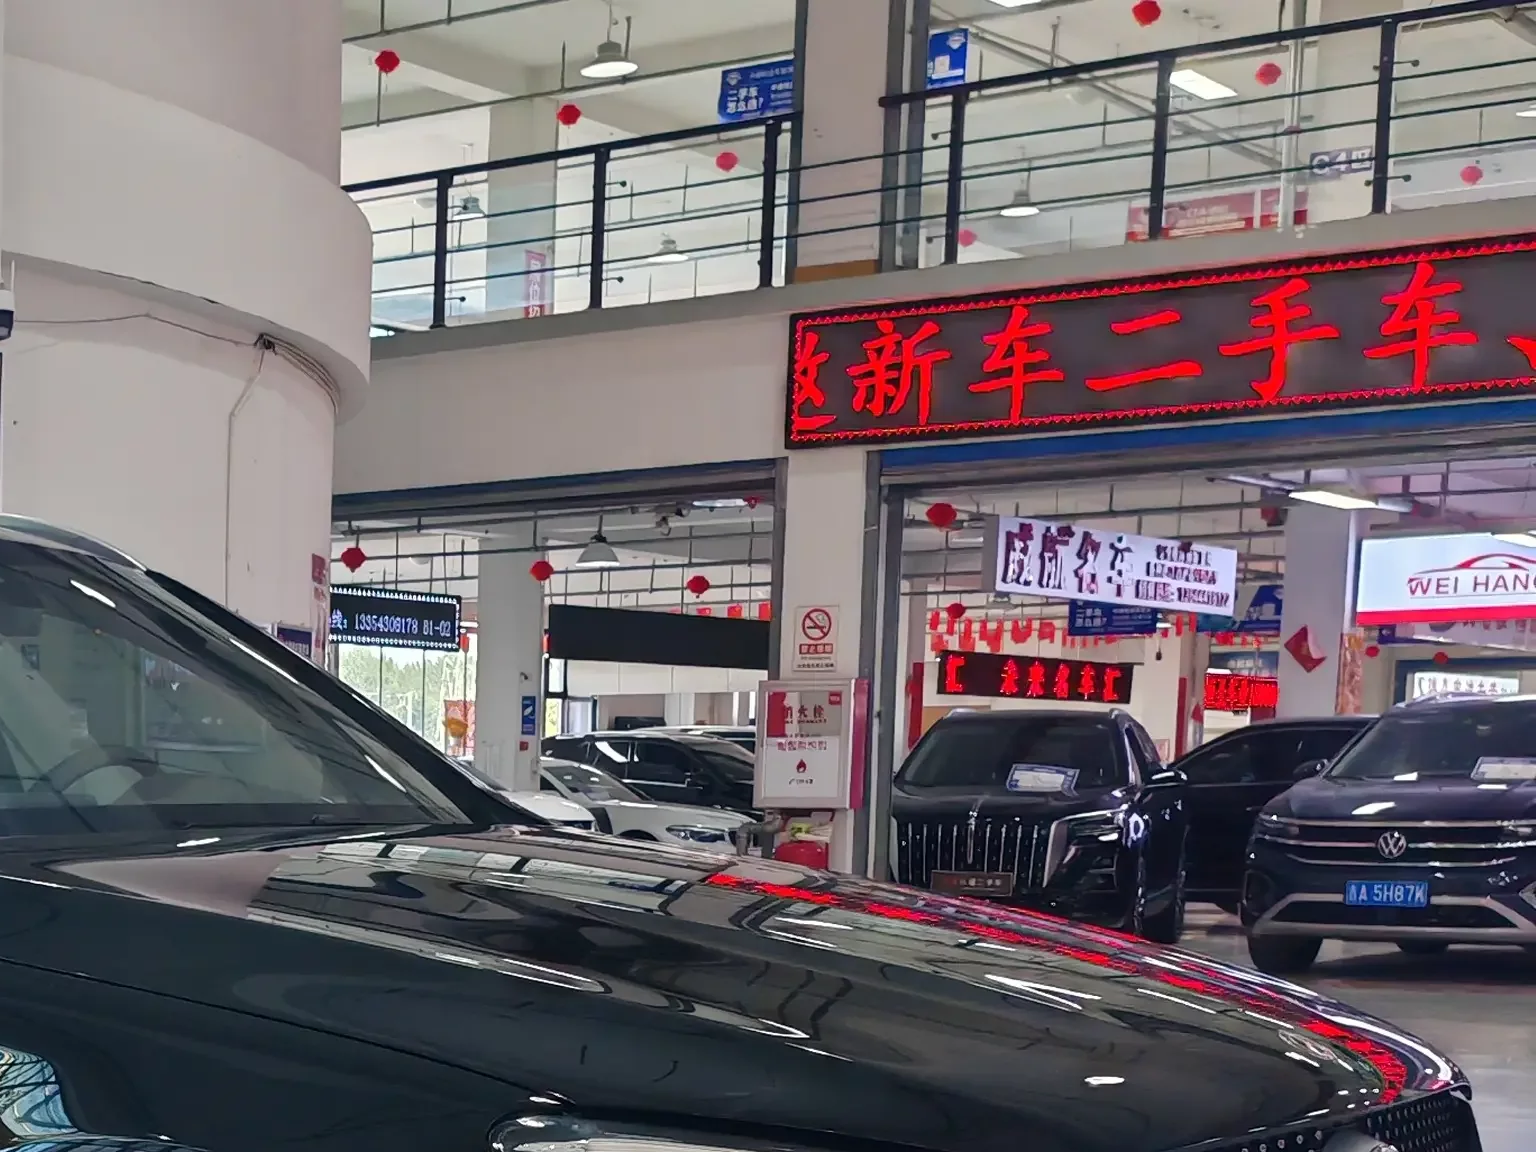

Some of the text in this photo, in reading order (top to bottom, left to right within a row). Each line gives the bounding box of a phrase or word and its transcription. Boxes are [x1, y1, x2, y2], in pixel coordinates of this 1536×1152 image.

[794, 262, 1536, 430] 新车二手车
[1407, 574, 1536, 596] WEI HAN
